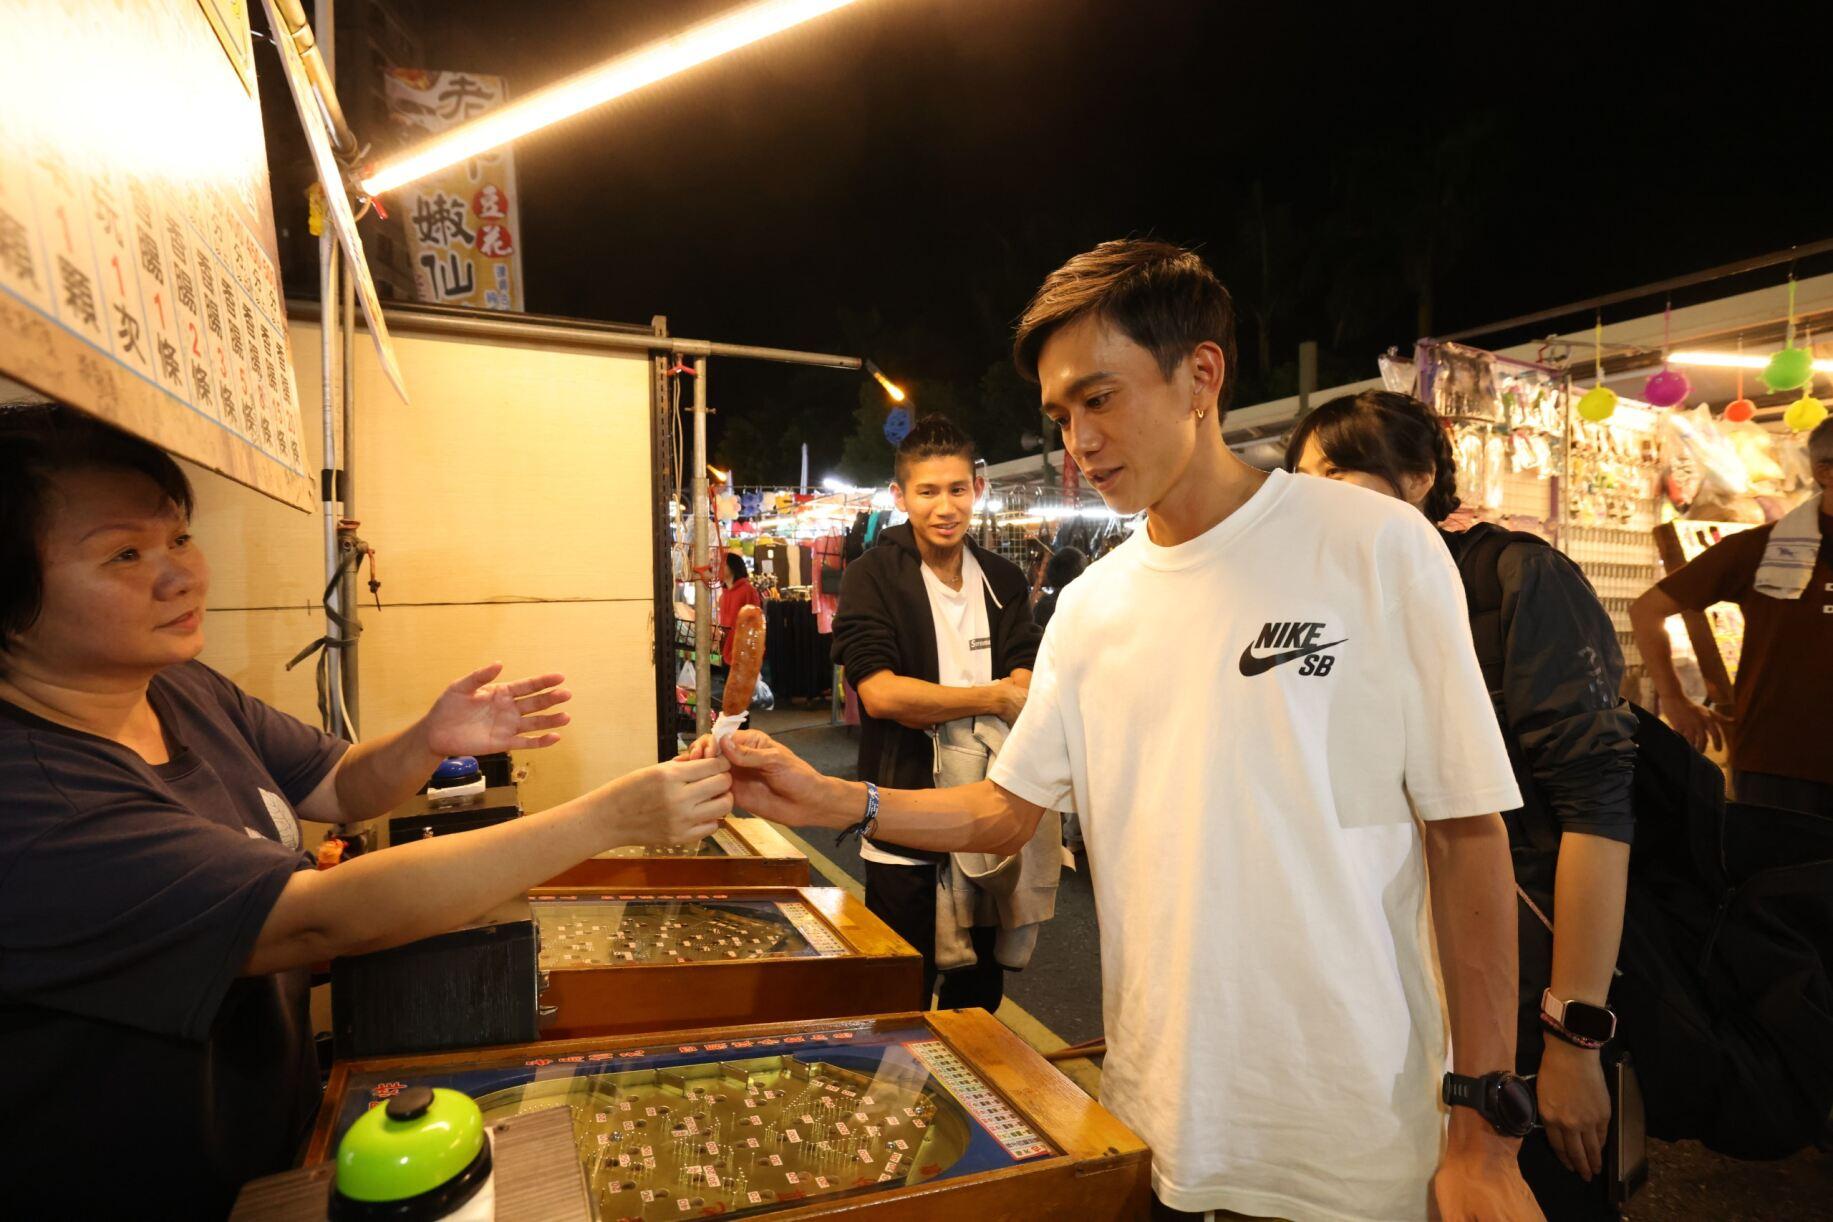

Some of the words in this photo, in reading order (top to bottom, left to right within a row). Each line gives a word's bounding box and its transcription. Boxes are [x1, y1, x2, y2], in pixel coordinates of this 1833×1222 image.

[479, 184, 513, 256] 豆花
[1254, 622, 1326, 649] NIKE
[1298, 654, 1335, 677] SB
